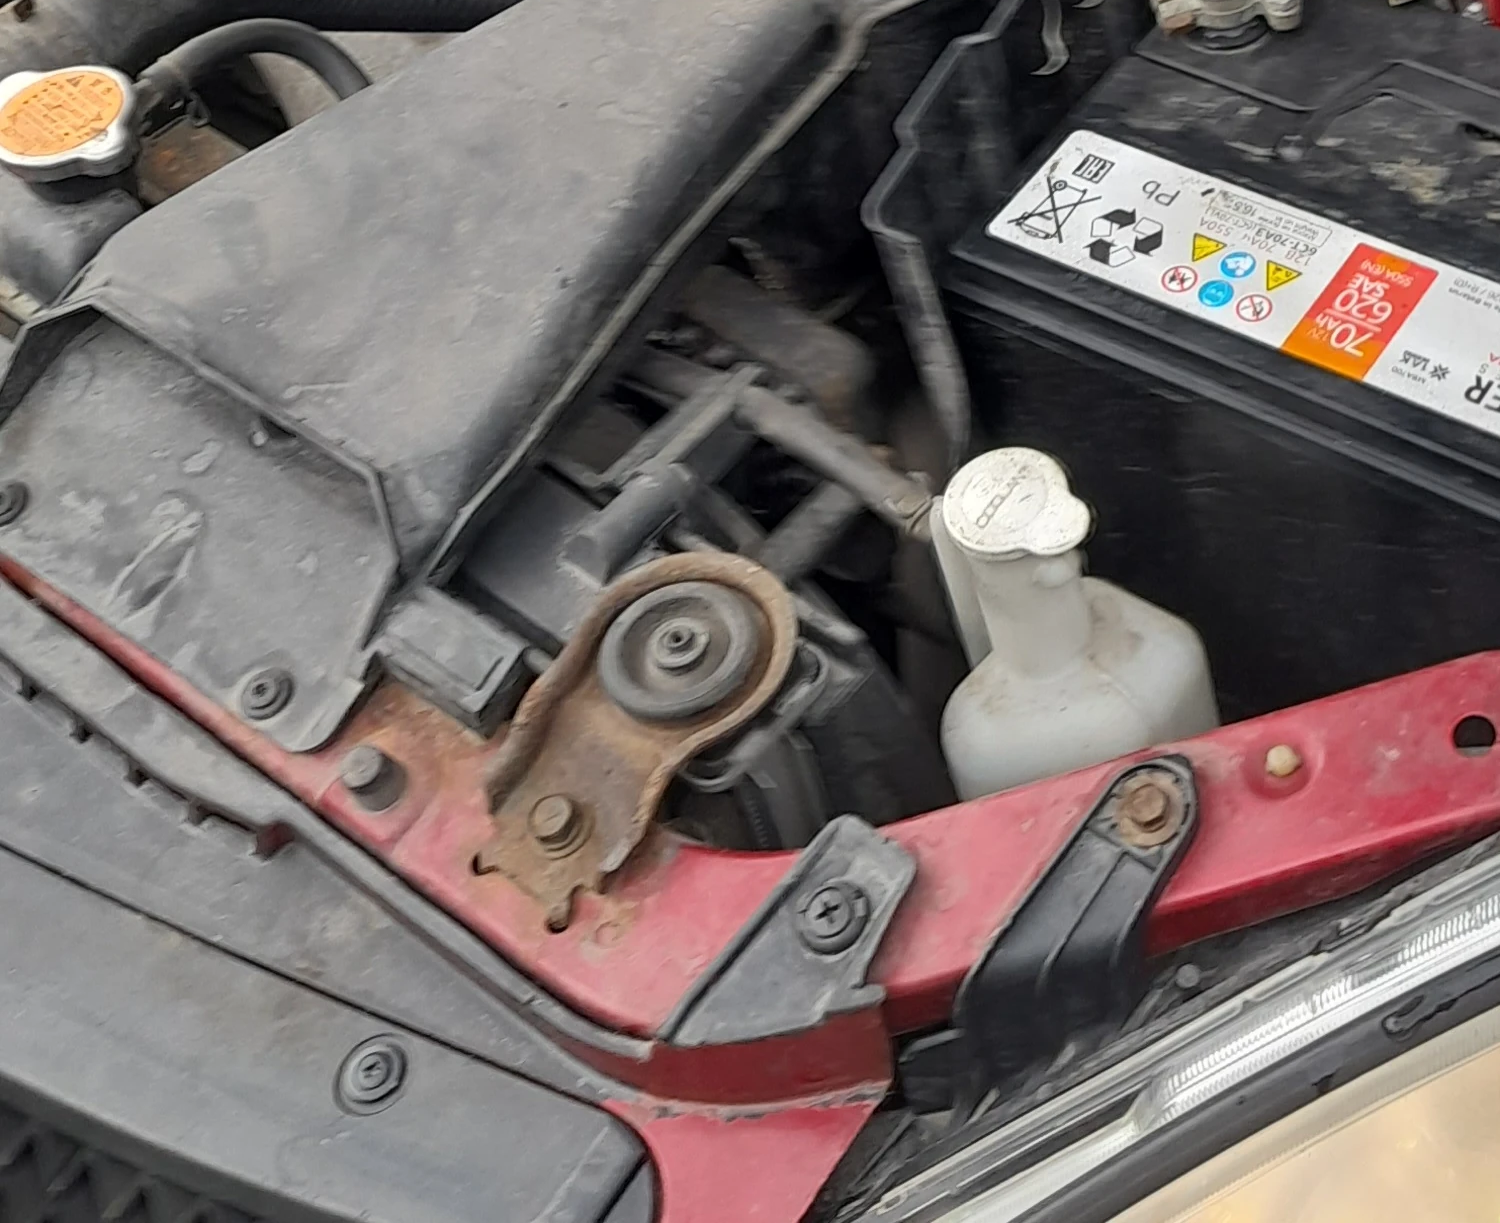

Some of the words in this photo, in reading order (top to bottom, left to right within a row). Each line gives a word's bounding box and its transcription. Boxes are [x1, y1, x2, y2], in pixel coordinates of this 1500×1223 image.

[1141, 179, 1181, 207] Pb
[1348, 273, 1388, 298] SAE
[1333, 287, 1392, 324] 620
